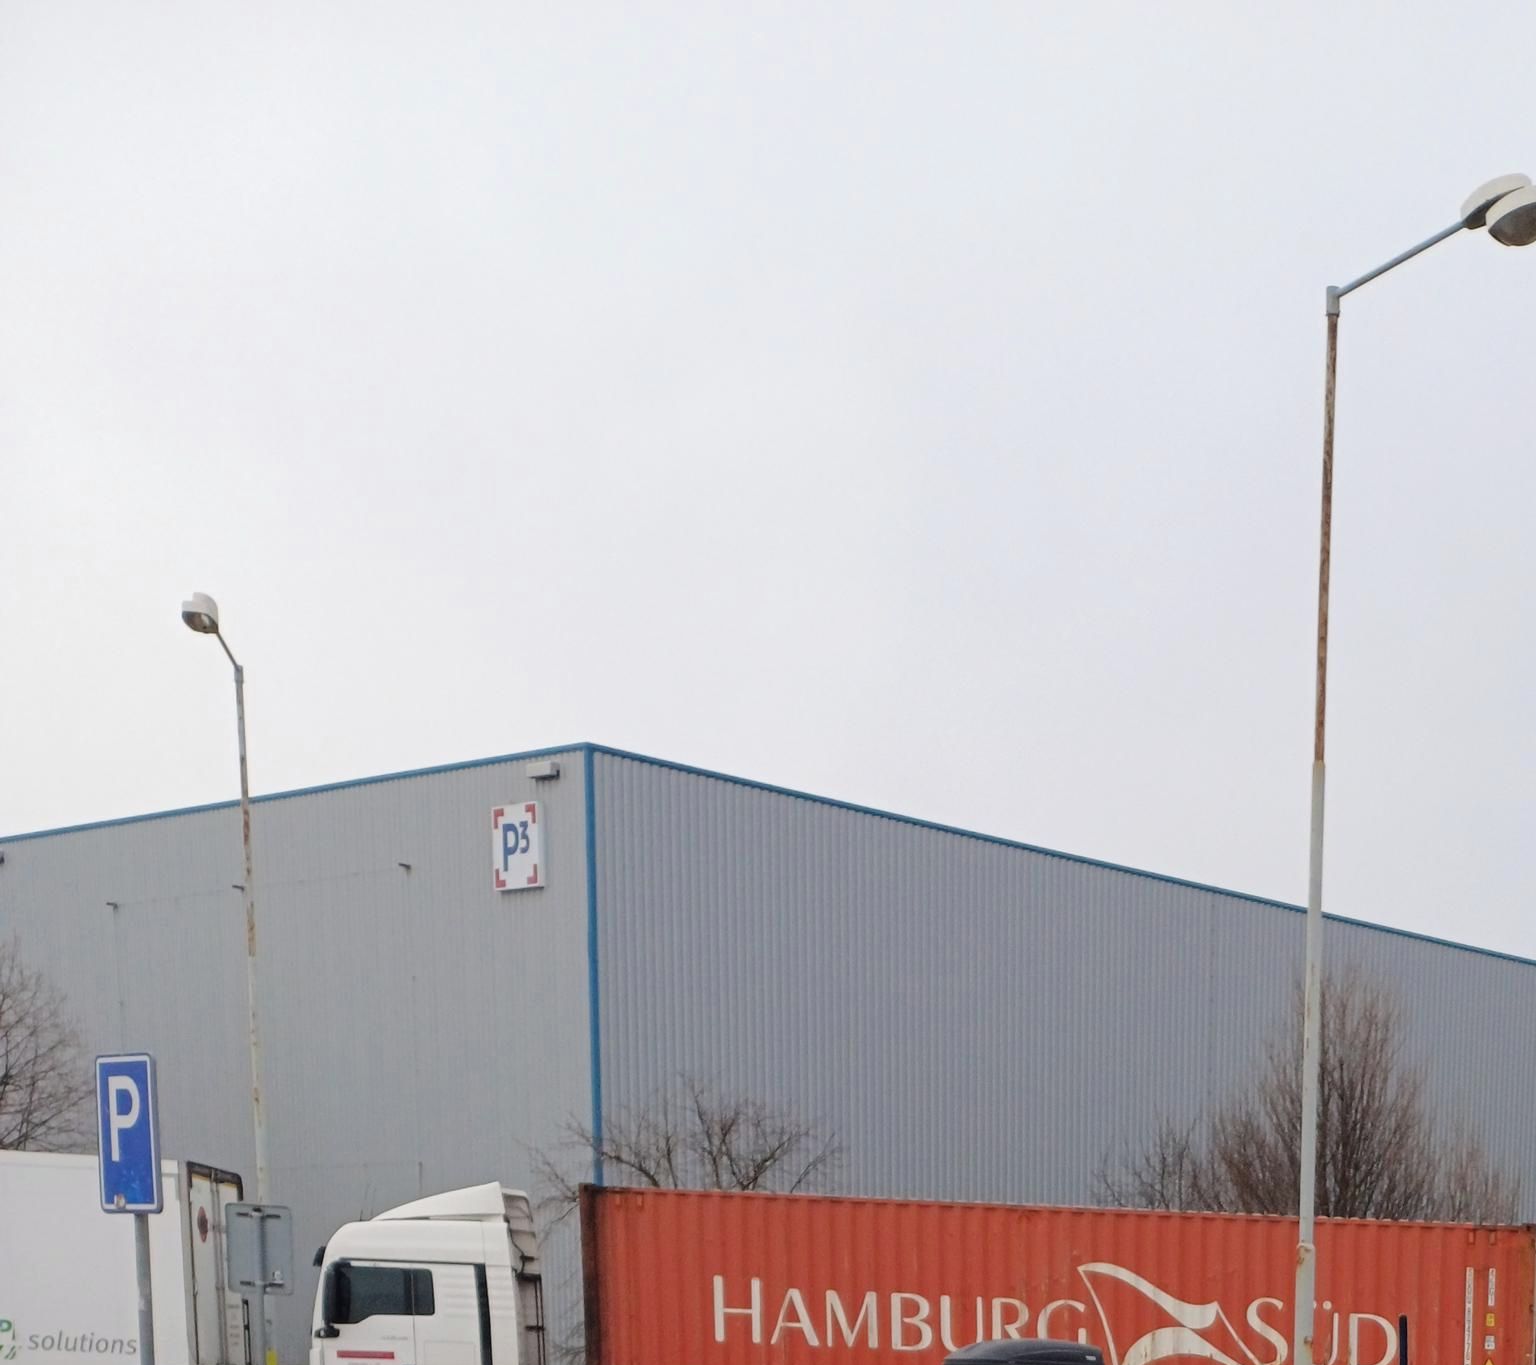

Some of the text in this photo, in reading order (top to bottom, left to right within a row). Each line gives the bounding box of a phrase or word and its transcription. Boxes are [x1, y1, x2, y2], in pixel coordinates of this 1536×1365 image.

[108, 1075, 140, 1162] P
[27, 1330, 138, 1355] solutions
[712, 1275, 1087, 1352] HAMBURG
